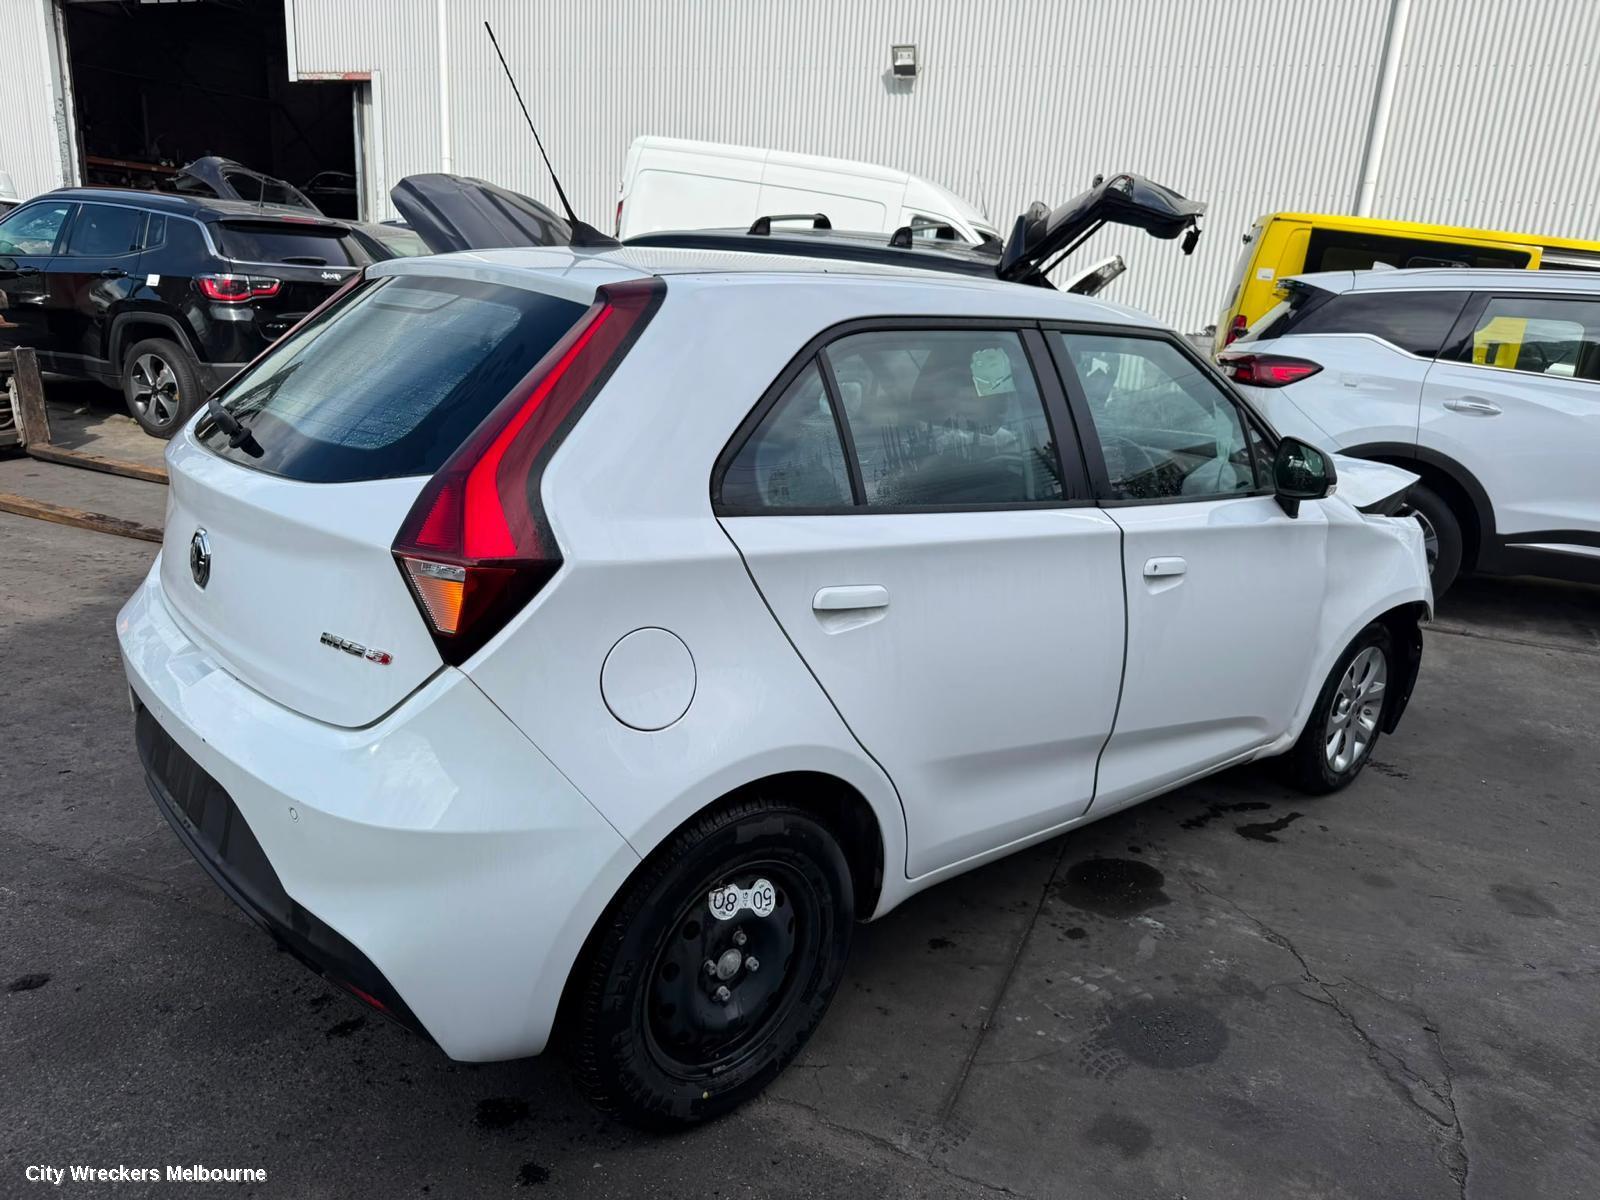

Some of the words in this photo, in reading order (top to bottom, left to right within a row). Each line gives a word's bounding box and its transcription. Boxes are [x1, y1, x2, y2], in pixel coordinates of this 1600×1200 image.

[321, 271, 341, 281] Jeep
[714, 891, 737, 911] 80
[753, 887, 772, 910] 50
